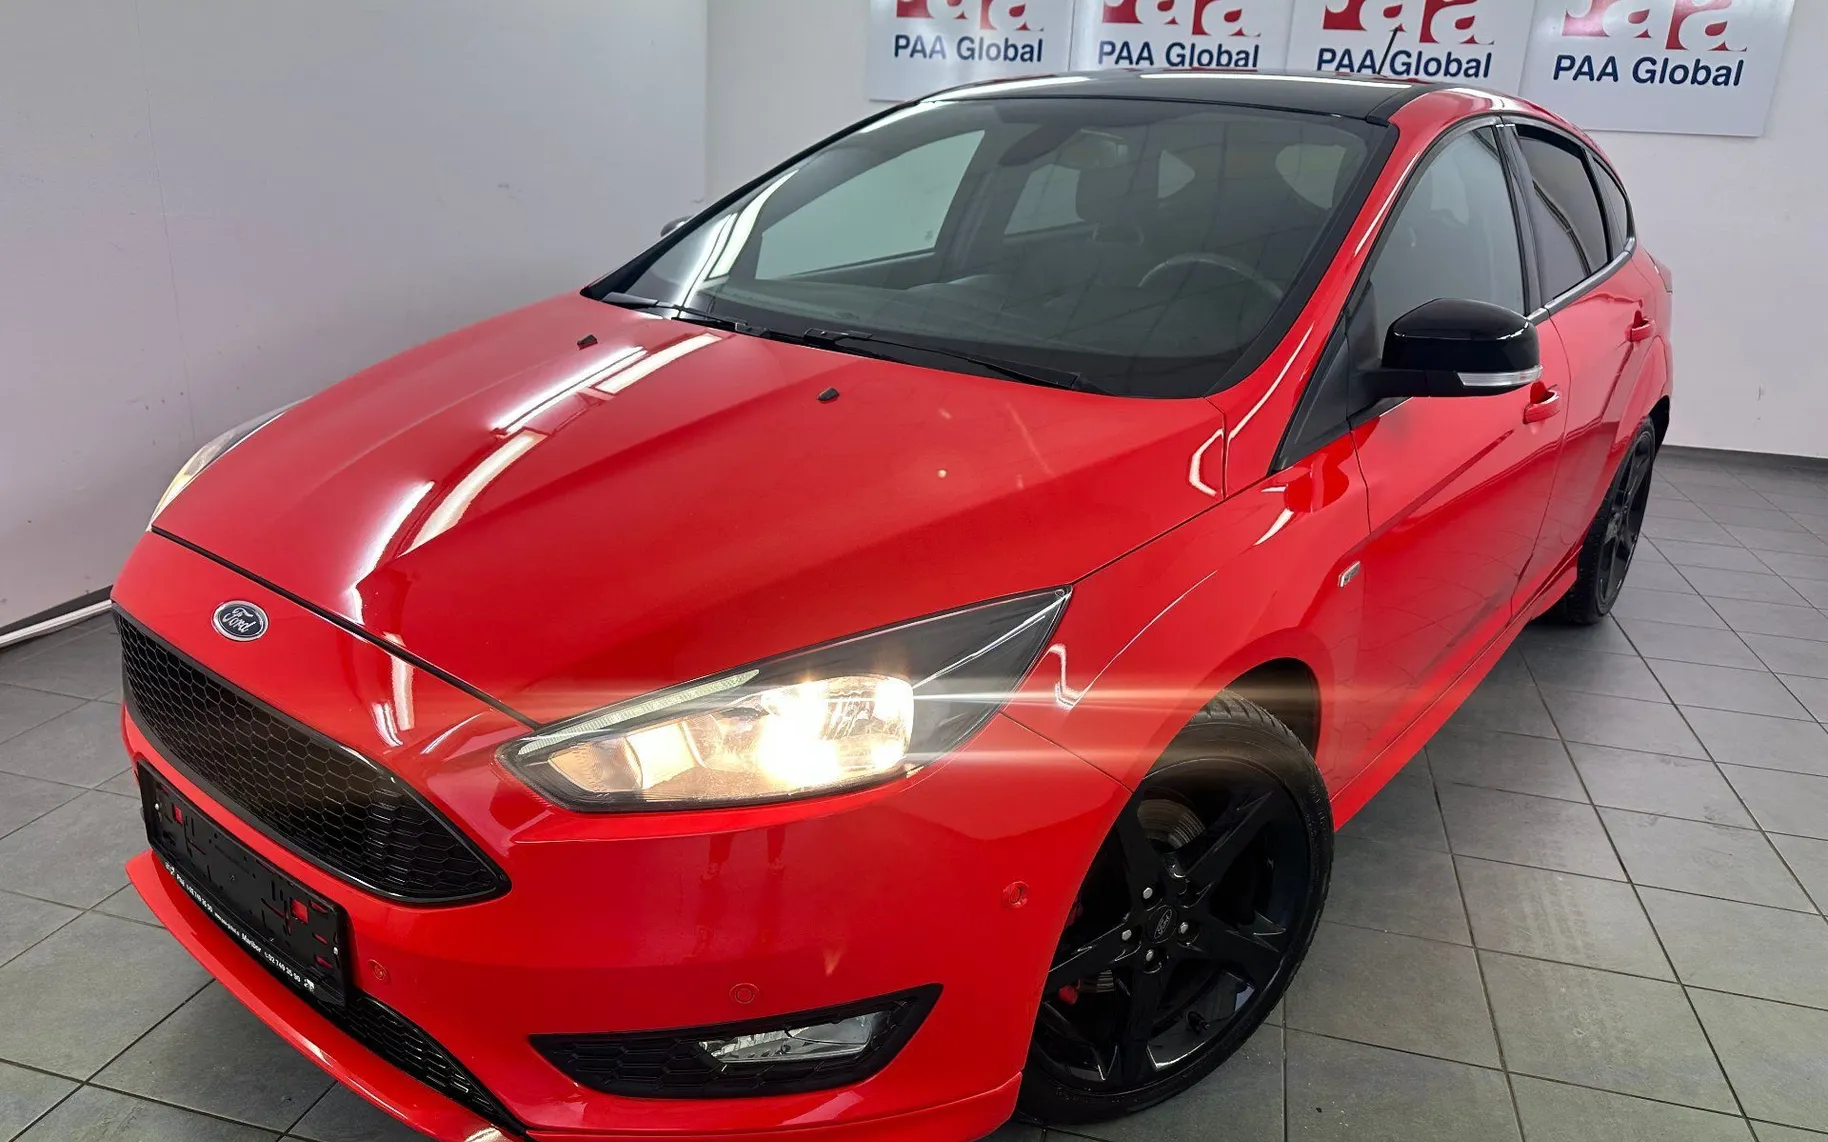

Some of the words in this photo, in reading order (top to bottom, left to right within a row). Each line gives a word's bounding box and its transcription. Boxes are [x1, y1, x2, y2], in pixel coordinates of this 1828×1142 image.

[894, 34, 947, 60] PAA
[956, 36, 1043, 63] Global
[1098, 40, 1155, 66] PAA
[1165, 42, 1260, 68] Global
[1317, 48, 1377, 74] PAA
[1389, 49, 1492, 78] Global
[1553, 54, 1619, 82] PAA
[1632, 56, 1745, 86] Global
[222, 607, 257, 633] Ford
